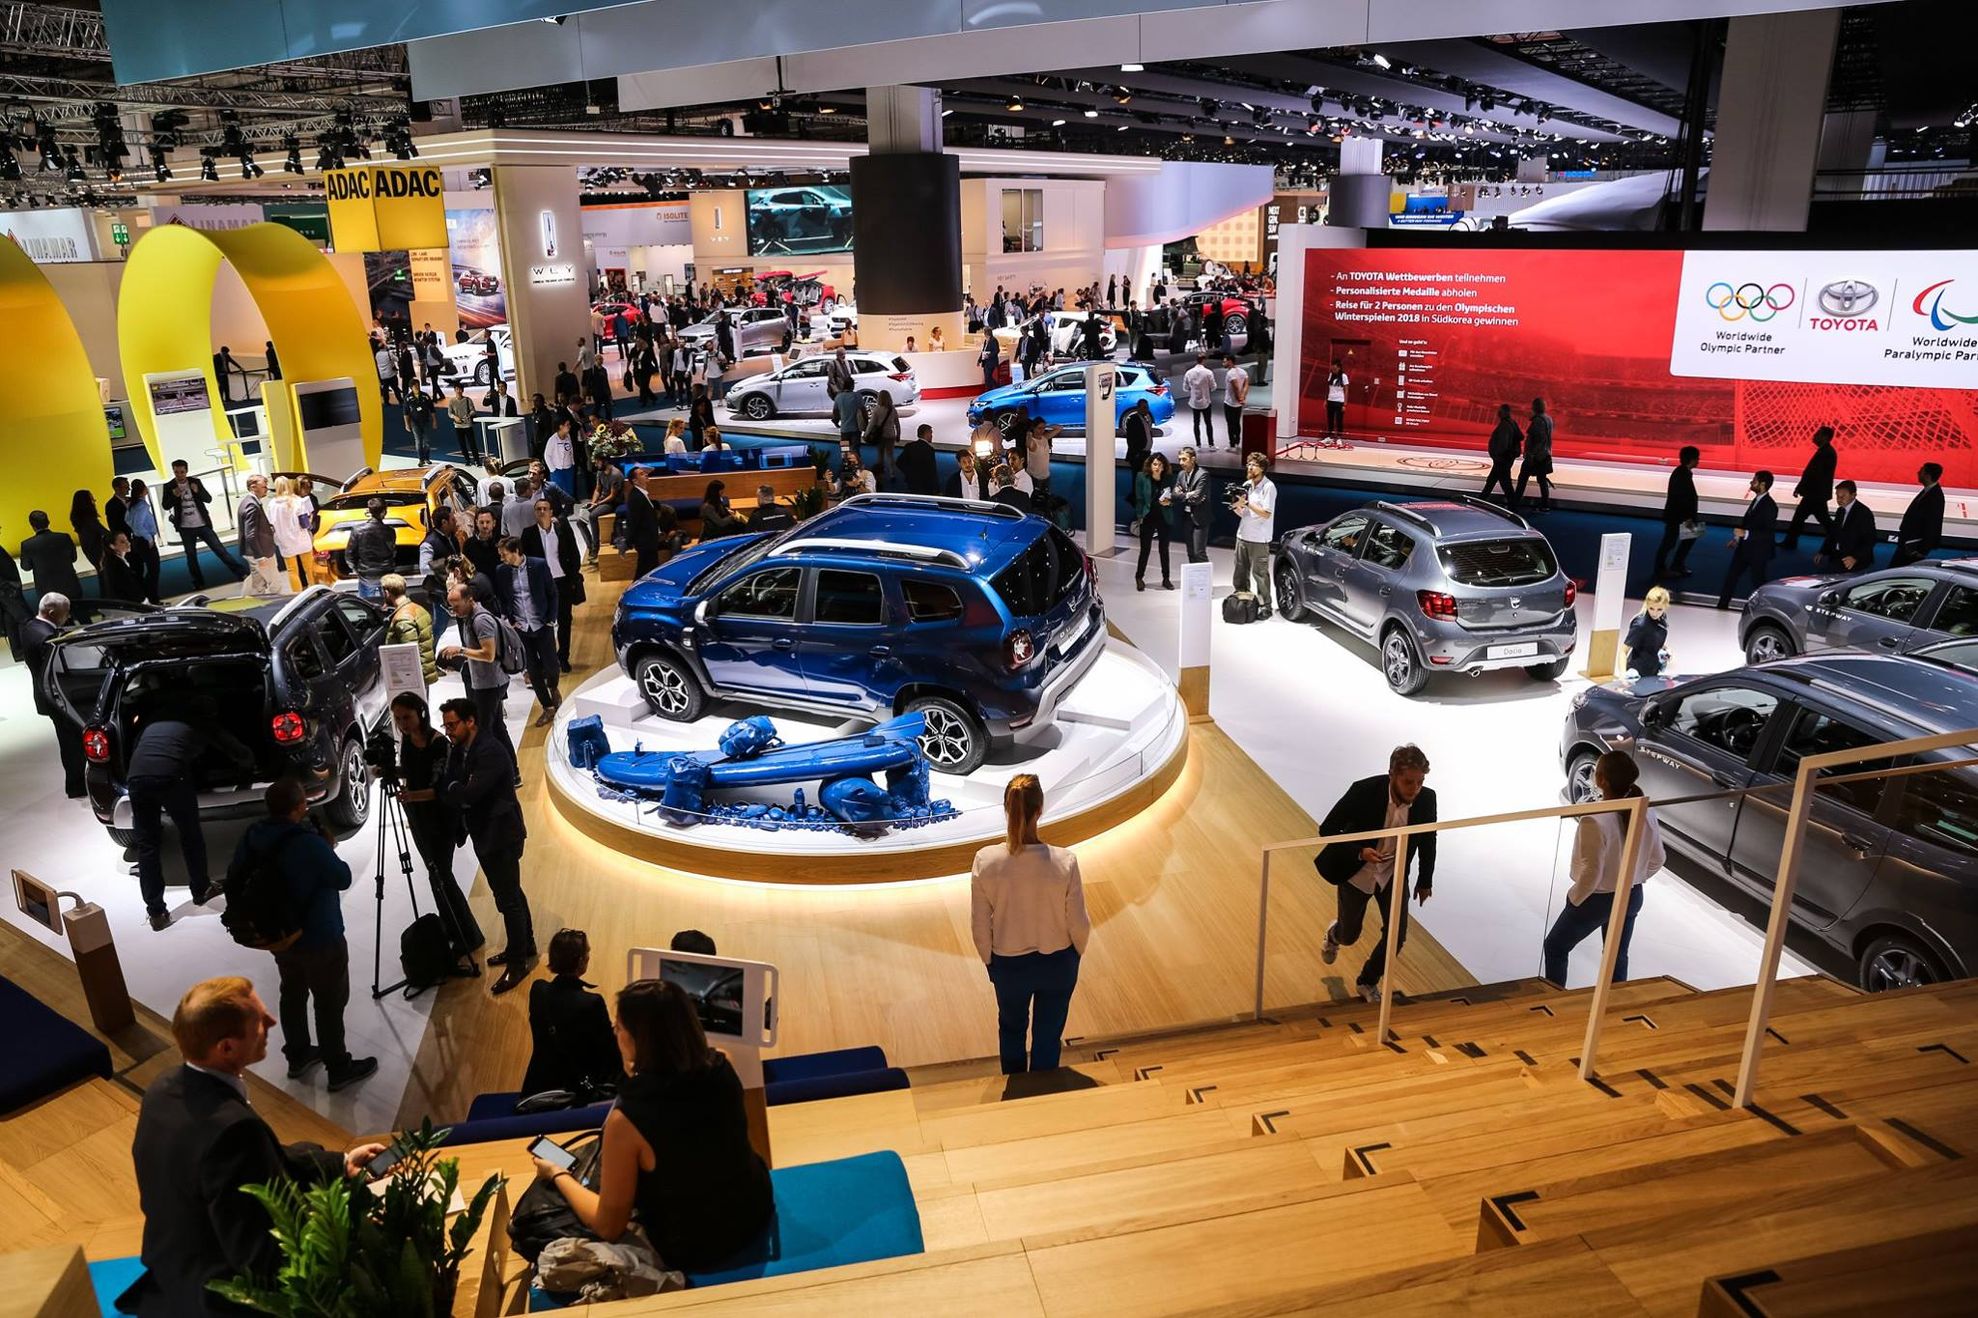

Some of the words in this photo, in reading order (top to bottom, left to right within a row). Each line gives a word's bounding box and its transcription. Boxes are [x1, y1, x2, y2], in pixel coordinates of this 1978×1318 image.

[327, 170, 370, 201] ADAC
[375, 170, 440, 198] ADAC
[664, 212, 688, 220] ISOLITE
[22, 237, 78, 259] LINAMAR
[1336, 272, 1348, 280] An
[1350, 272, 1384, 281] TOYOTA
[1385, 272, 1453, 282] Wettbewerben
[1454, 273, 1506, 283] teilnehmen
[1335, 287, 1401, 296] Personalisierte
[1402, 287, 1440, 296] Medaille
[1441, 287, 1477, 297] abholen
[1335, 301, 1358, 309] Reise
[1359, 301, 1373, 310] für
[1374, 302, 1380, 310] 2
[1381, 302, 1423, 311] Personen
[1436, 303, 1453, 311] den
[1454, 303, 1515, 314] Olympischen
[1335, 312, 1396, 322] Winterspielen
[1397, 313, 1420, 323] 2018
[1421, 314, 1430, 323] in
[1431, 314, 1473, 324] Südkorea
[1474, 316, 1519, 327] gewinnen
[1809, 318, 1879, 332] TOYOTA
[1715, 331, 1773, 342] Worldwide
[1912, 336, 1978, 348] Worldwide
[1700, 342, 1742, 354] Olympic
[1745, 344, 1786, 355] Partner
[1883, 348, 1951, 361] Paralympic
[1955, 350, 1978, 361] Par
[1816, 607, 1852, 621] STEPWAY
[1639, 746, 1681, 769] STEPWAY
